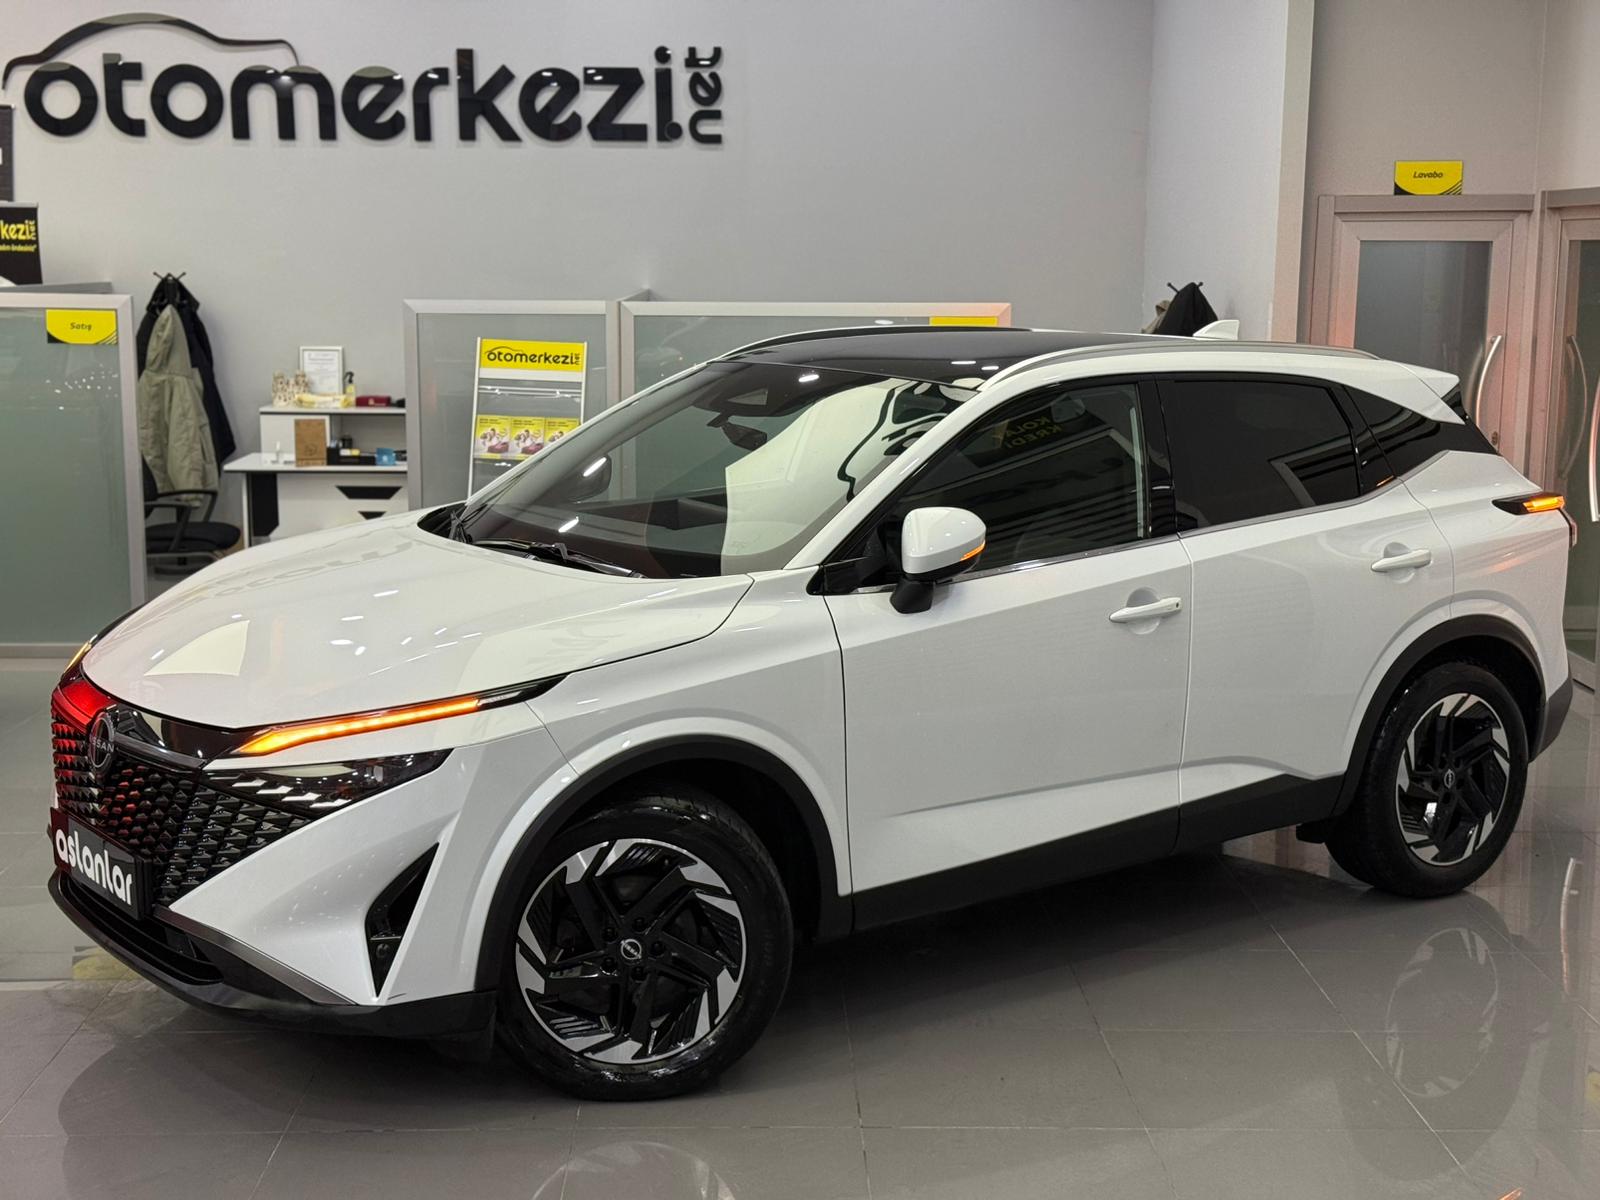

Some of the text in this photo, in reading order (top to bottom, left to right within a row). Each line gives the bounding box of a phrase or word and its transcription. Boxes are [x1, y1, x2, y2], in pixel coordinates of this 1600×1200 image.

[24, 46, 673, 143] otomerkezi
[1413, 171, 1443, 179] Lavabo
[487, 351, 575, 366] otomerkezi
[55, 828, 133, 905] aslanlar
